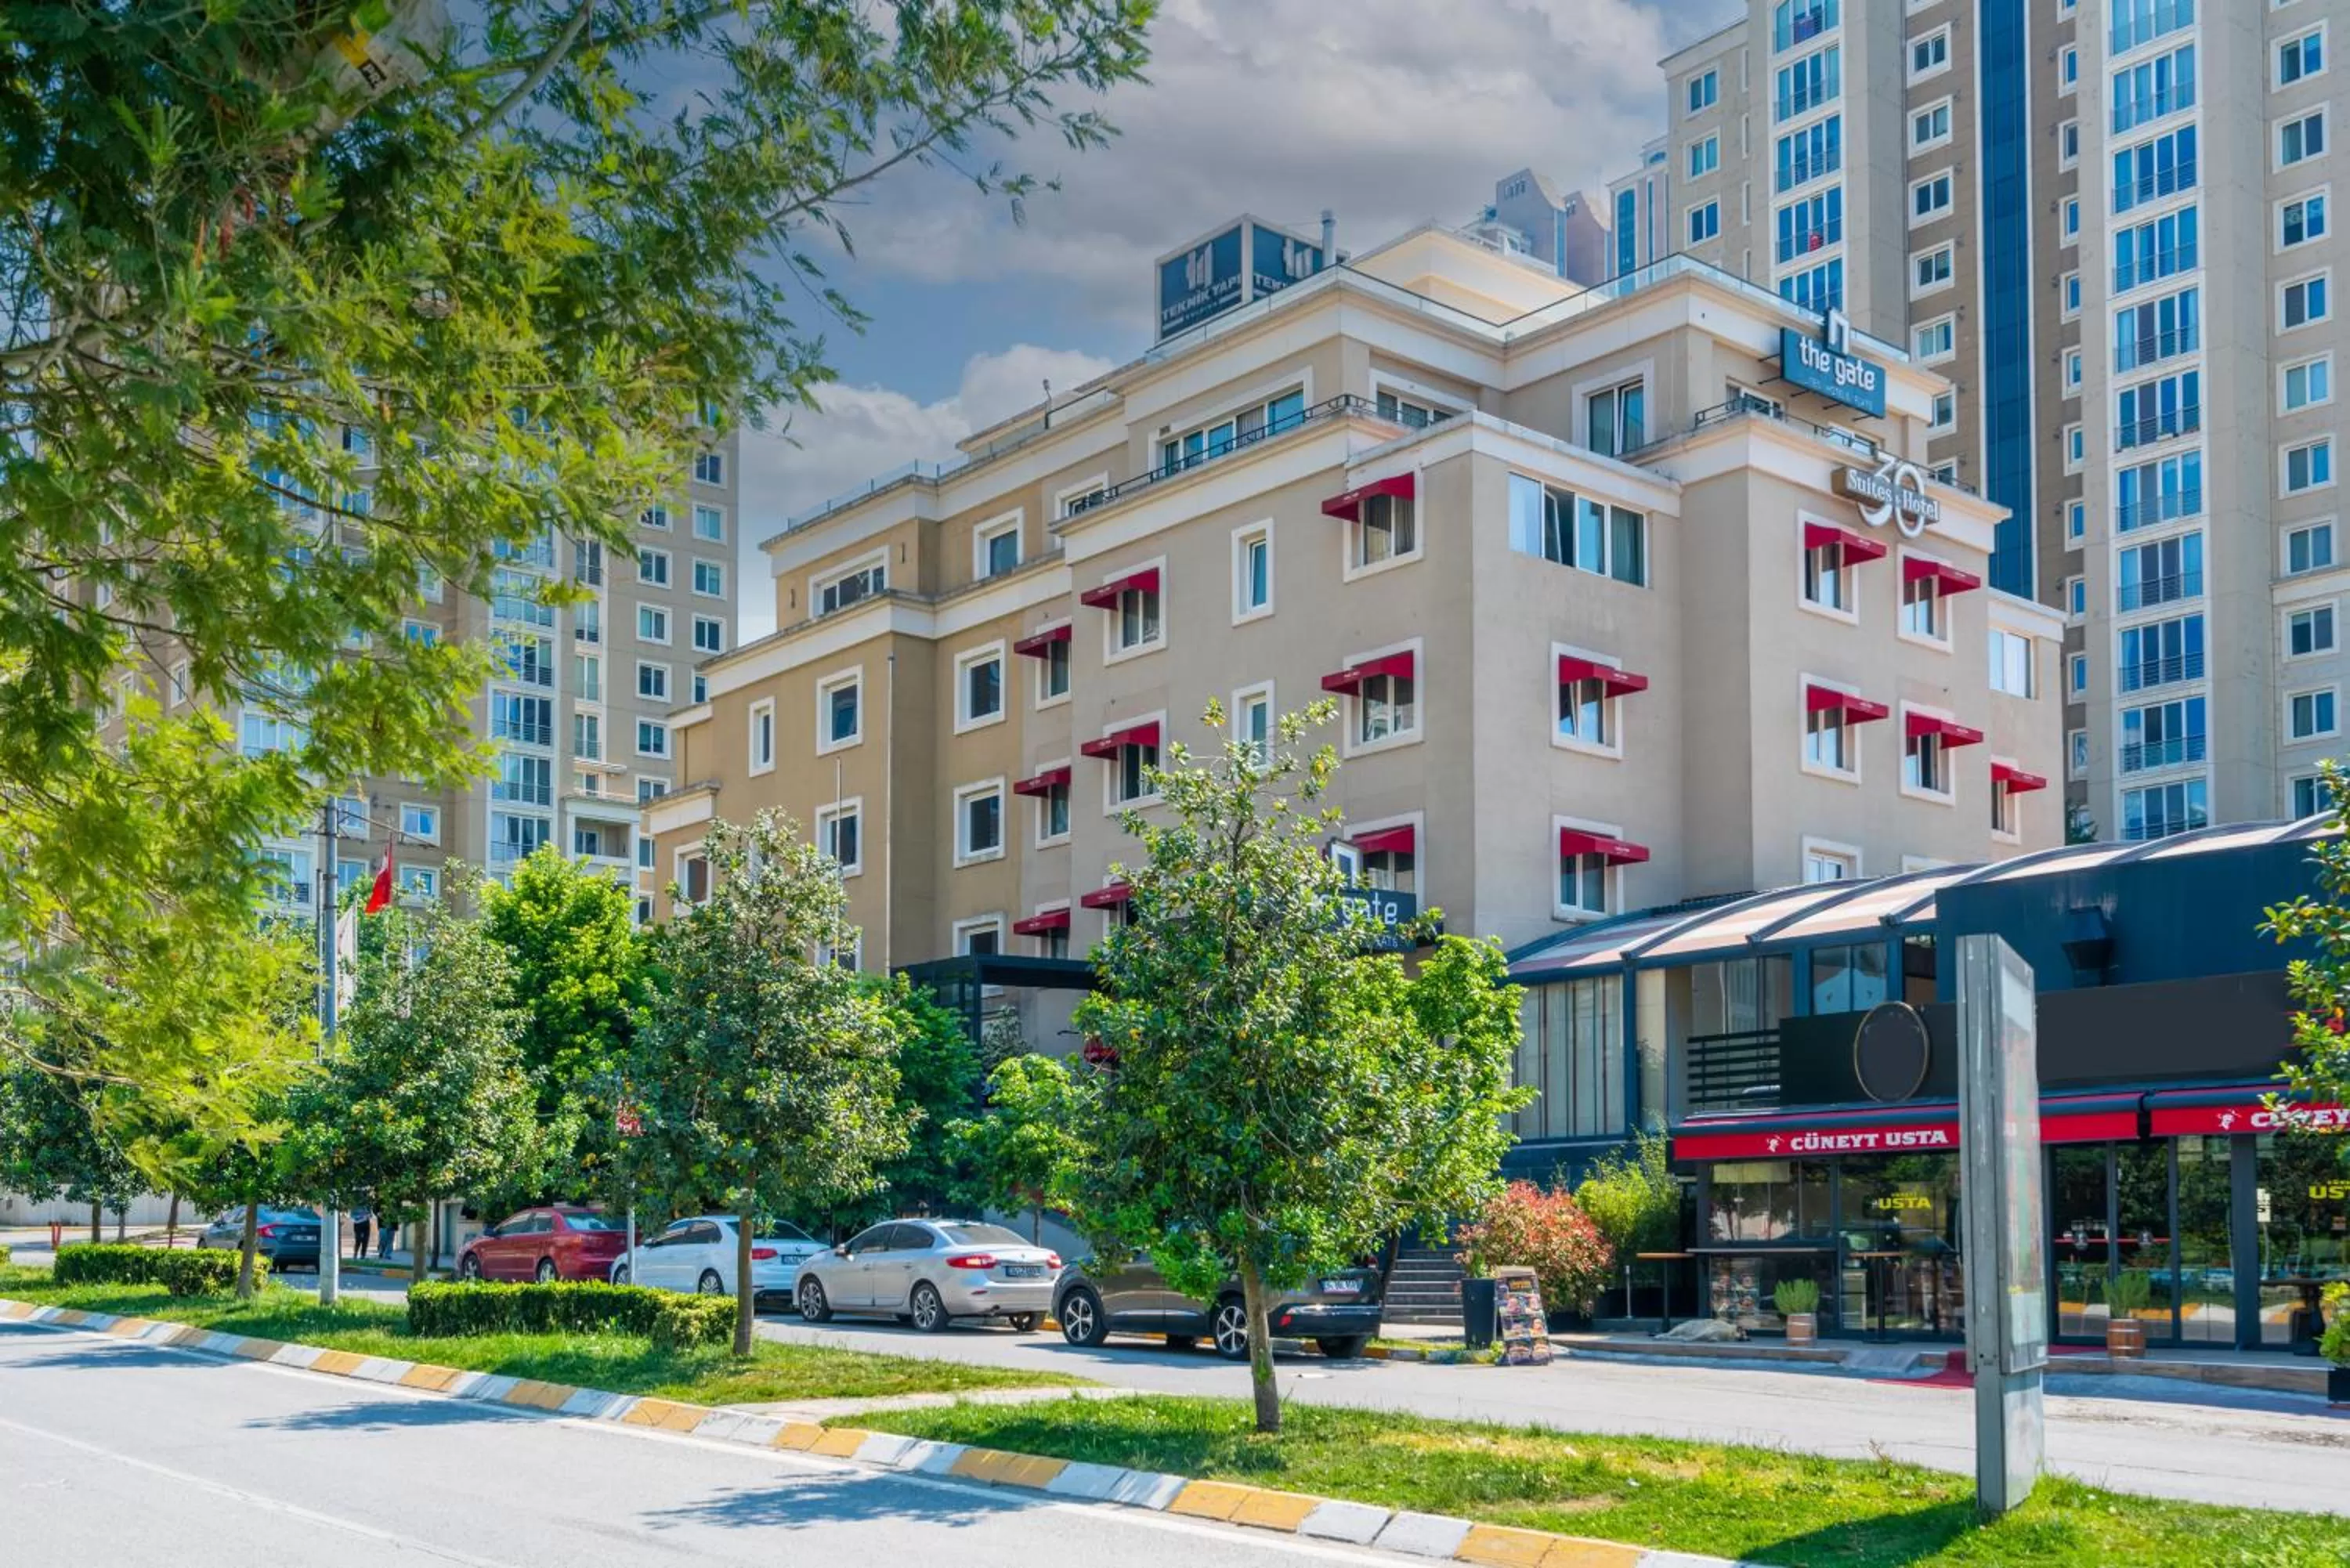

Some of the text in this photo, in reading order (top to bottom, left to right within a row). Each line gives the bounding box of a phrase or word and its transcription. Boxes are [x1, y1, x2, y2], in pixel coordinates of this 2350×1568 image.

[1799, 336, 1875, 391] the gate
[1849, 470, 1893, 502] Suites
[1903, 490, 1940, 522] Hotel
[1791, 1130, 1949, 1151] CÜNEYT USTA
[1879, 1197, 1932, 1209] USTA
